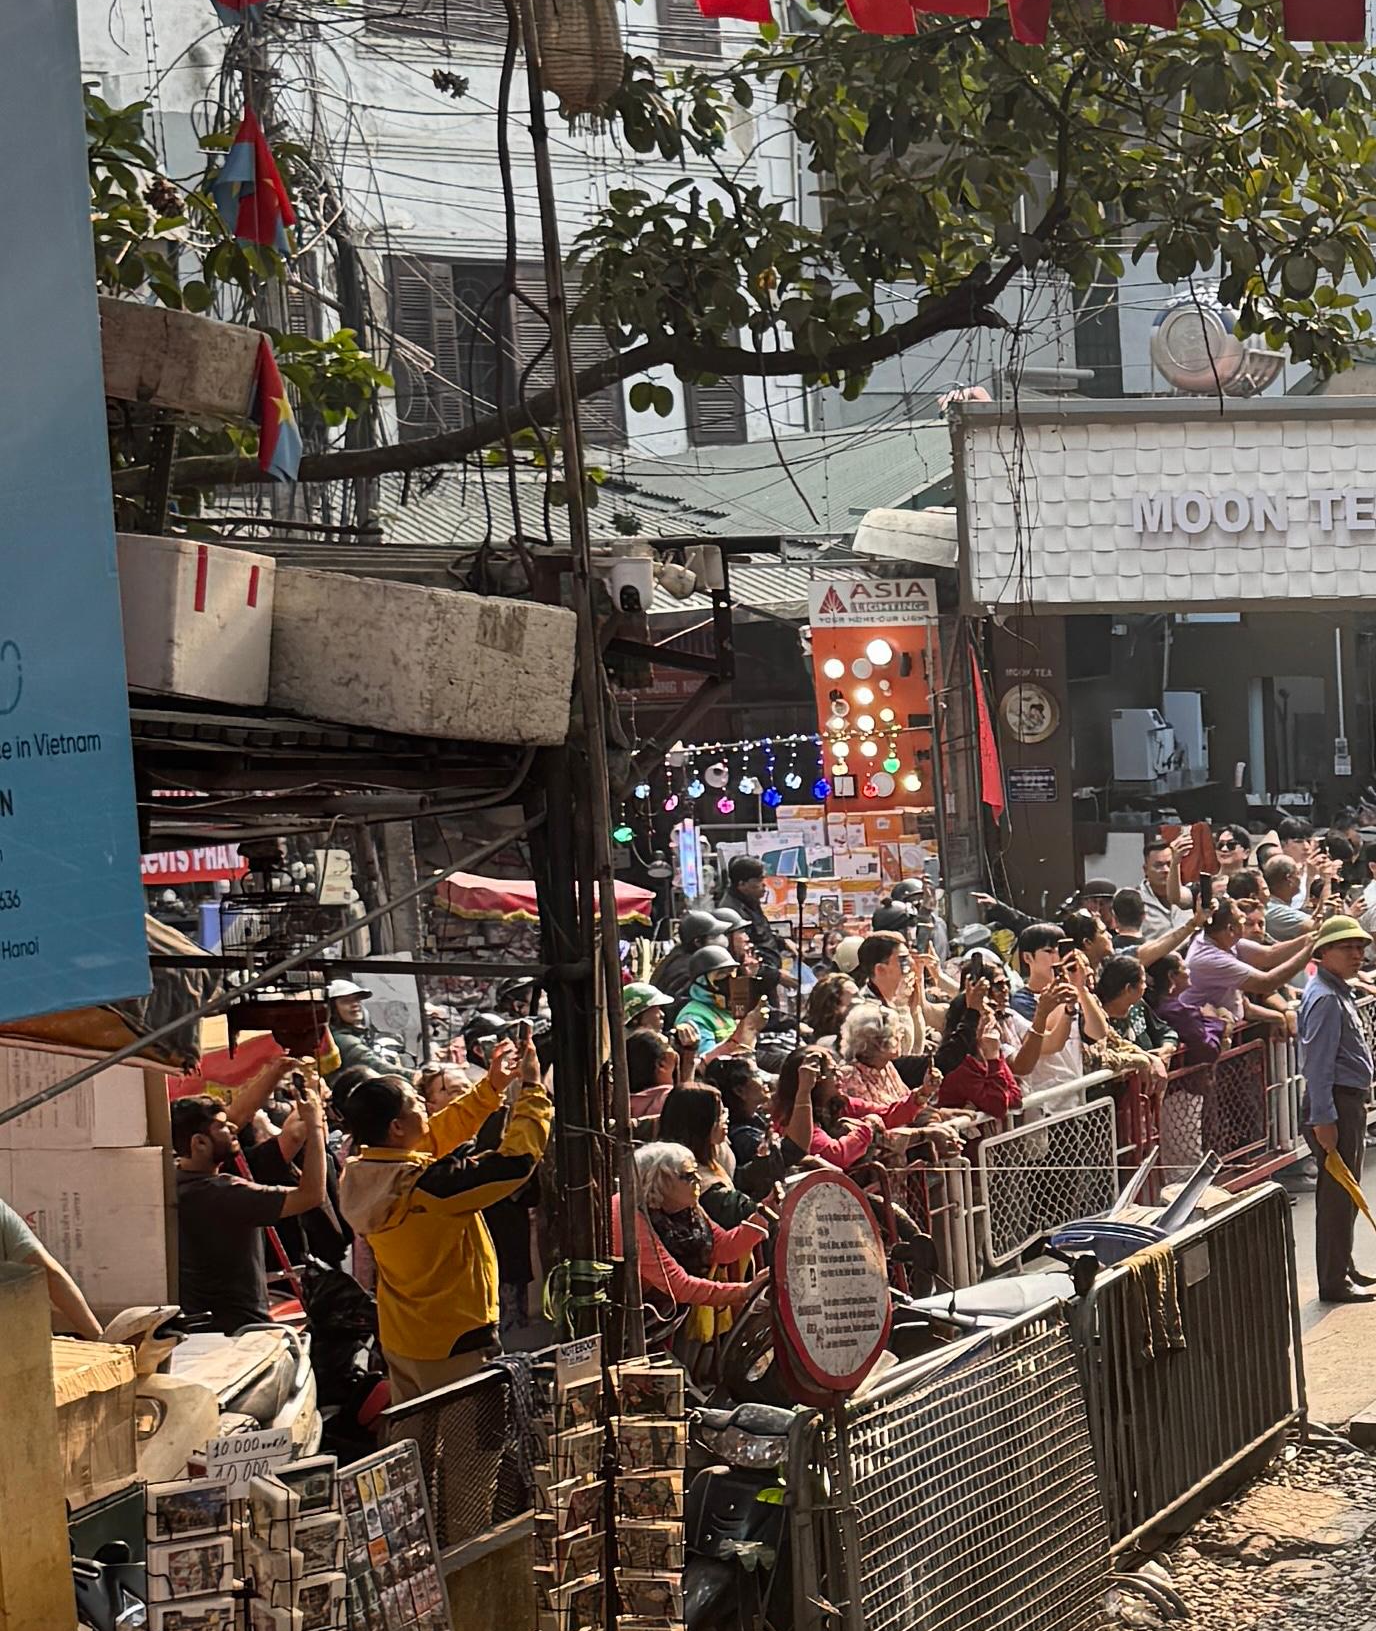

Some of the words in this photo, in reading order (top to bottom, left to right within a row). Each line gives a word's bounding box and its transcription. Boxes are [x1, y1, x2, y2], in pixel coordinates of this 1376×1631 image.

[1132, 489, 1288, 533] MOON
[850, 581, 928, 599] ASIA
[854, 603, 924, 612] LIGHTING
[16, 734, 31, 758] in
[33, 731, 101, 758] Vietnam
[2, 936, 39, 960] Hanoi
